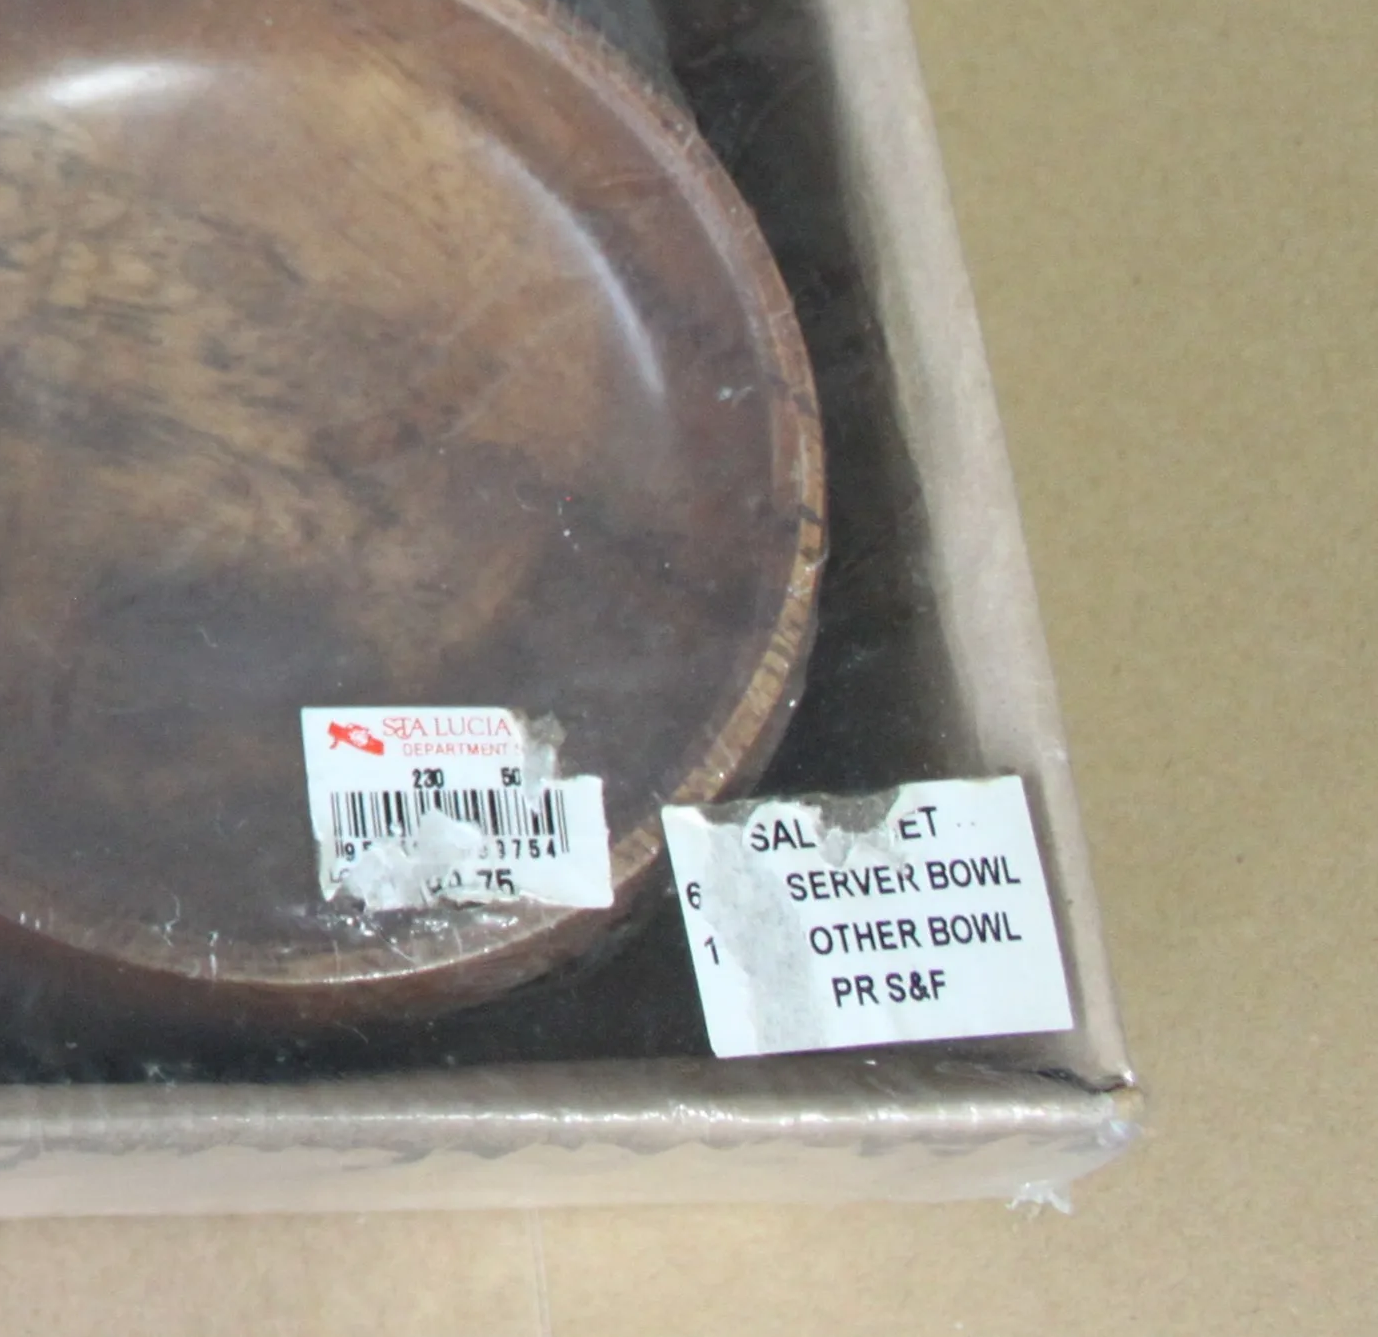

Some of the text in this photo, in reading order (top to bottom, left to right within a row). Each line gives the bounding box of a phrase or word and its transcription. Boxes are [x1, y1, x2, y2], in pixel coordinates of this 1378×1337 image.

[434, 716, 511, 737] LUCIA
[403, 743, 508, 757] DEPARTMENT
[686, 855, 1021, 910] 6 SERVER BOWL
[703, 912, 1023, 965] 1 OTHER BOWL
[832, 969, 947, 1008] PR S&F
